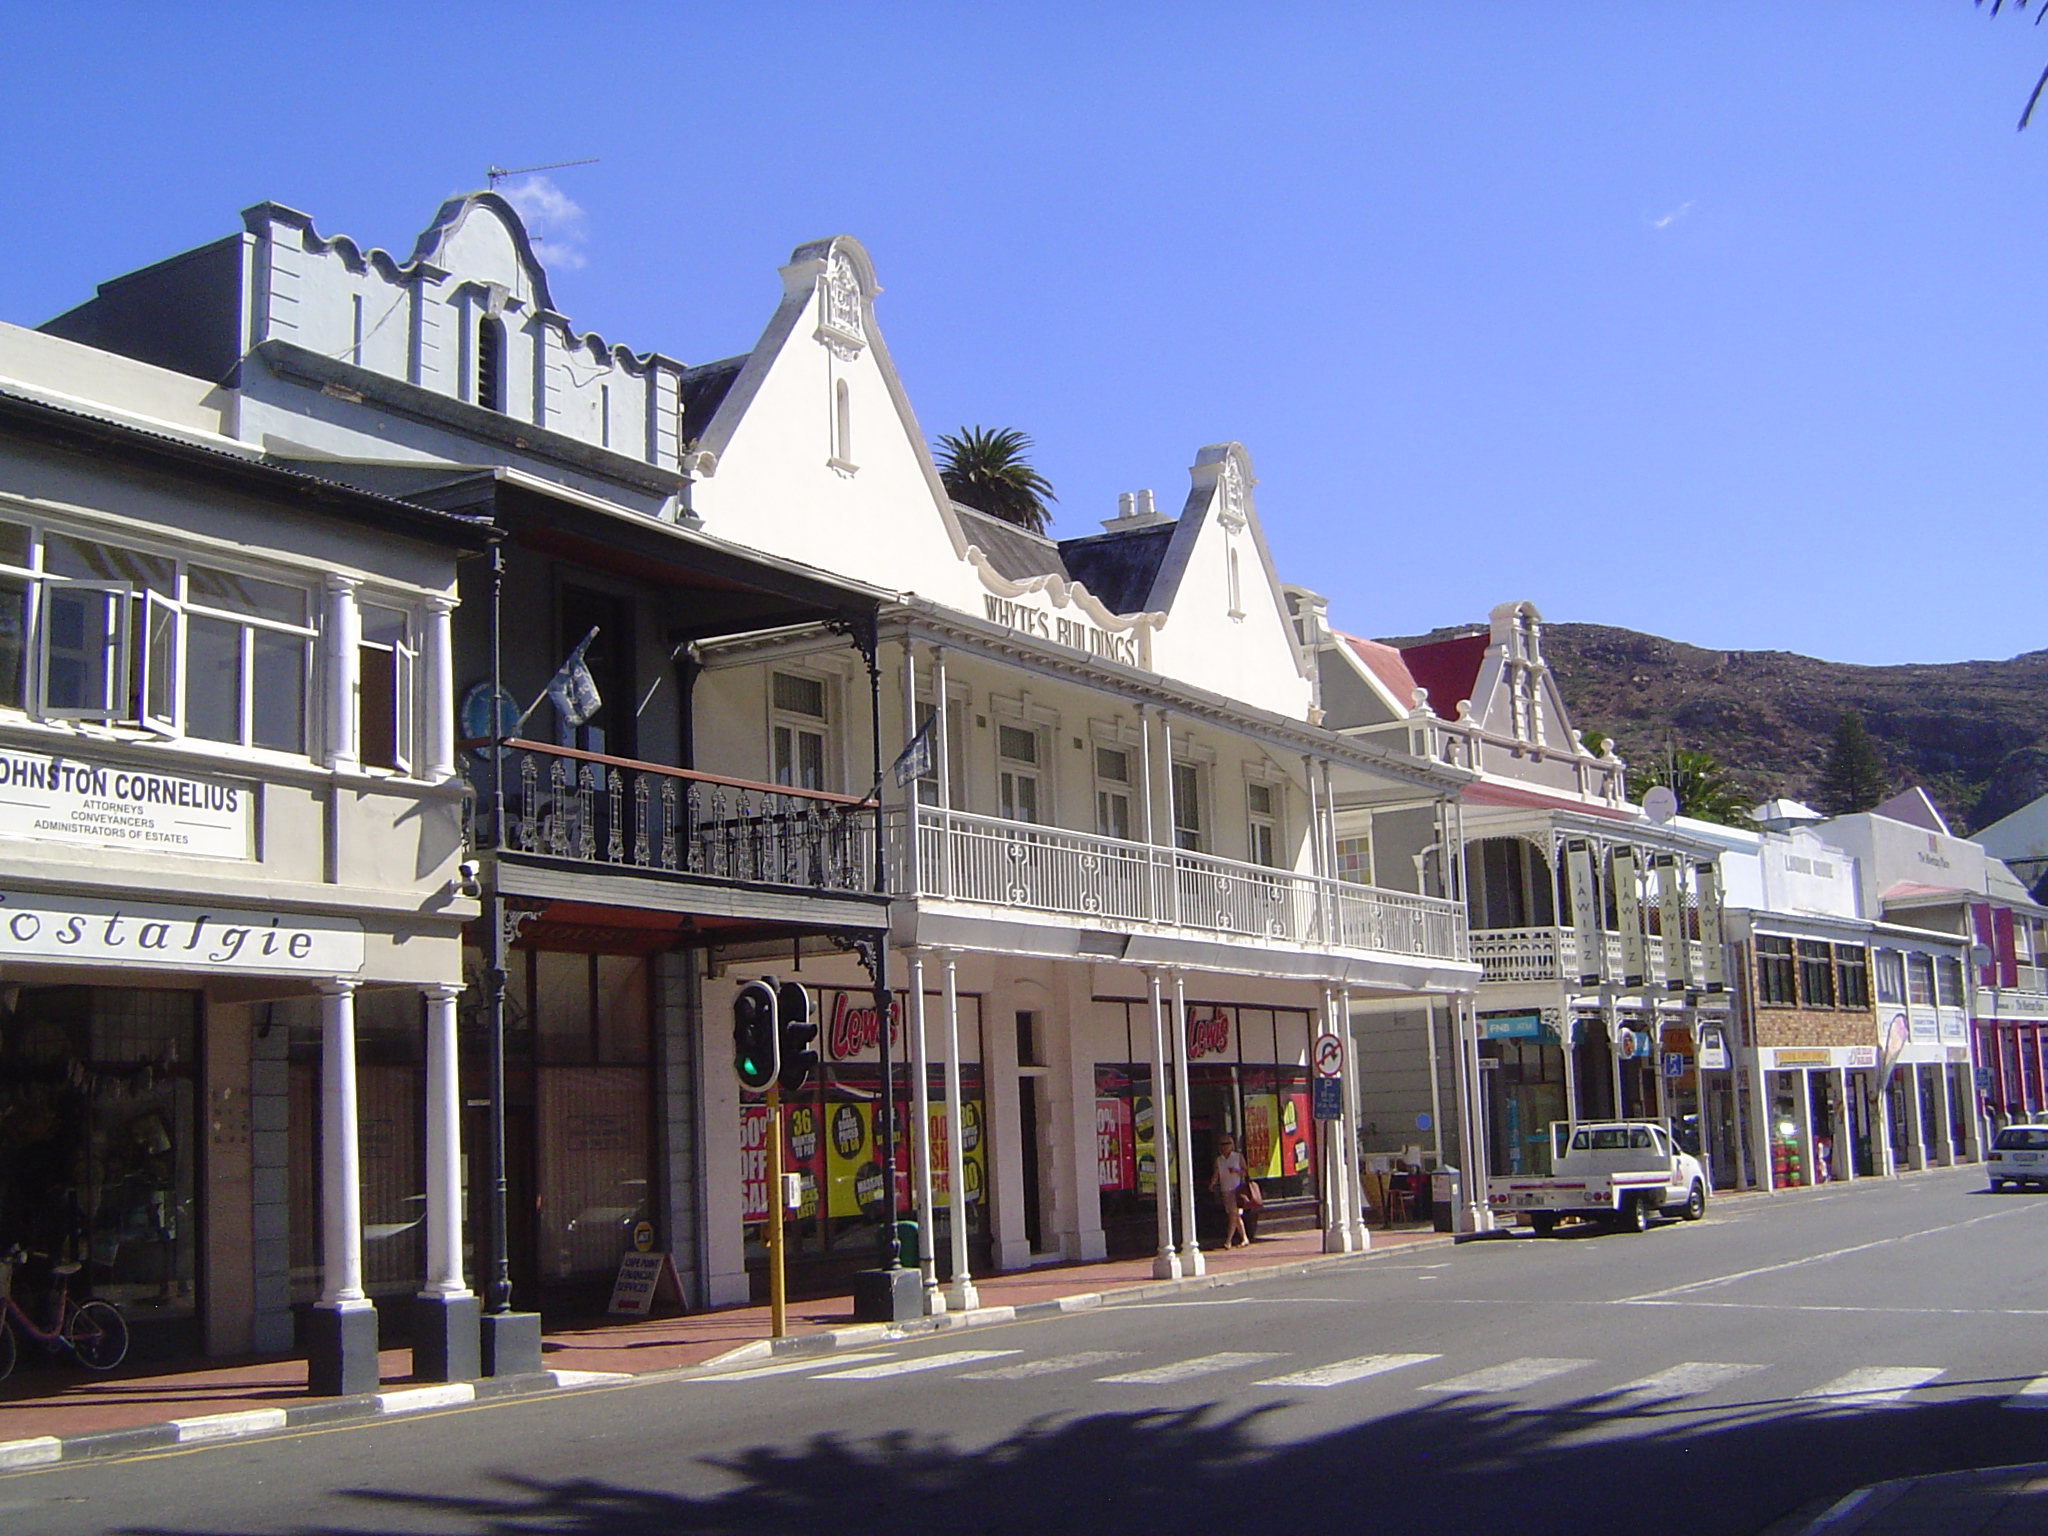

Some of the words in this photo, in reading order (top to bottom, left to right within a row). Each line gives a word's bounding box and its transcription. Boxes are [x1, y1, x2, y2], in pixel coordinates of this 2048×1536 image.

[83, 799, 144, 815] ATTORNEYS
[115, 774, 238, 813] CORNELIUS
[34, 819, 126, 838] ADMINISTRATORS
[129, 830, 142, 840] OF
[145, 831, 189, 845] ESTATES
[71, 810, 155, 828] CONVEYANCERS
[0, 894, 313, 963] ostalgie
[1576, 871, 1592, 960] JAWITZ
[1621, 877, 1636, 962] JAWITZ
[1663, 885, 1677, 967] JAWITZ
[1703, 891, 1718, 970] JAWITZ
[1489, 1023, 1510, 1034] FNB
[792, 1109, 811, 1136] 36
